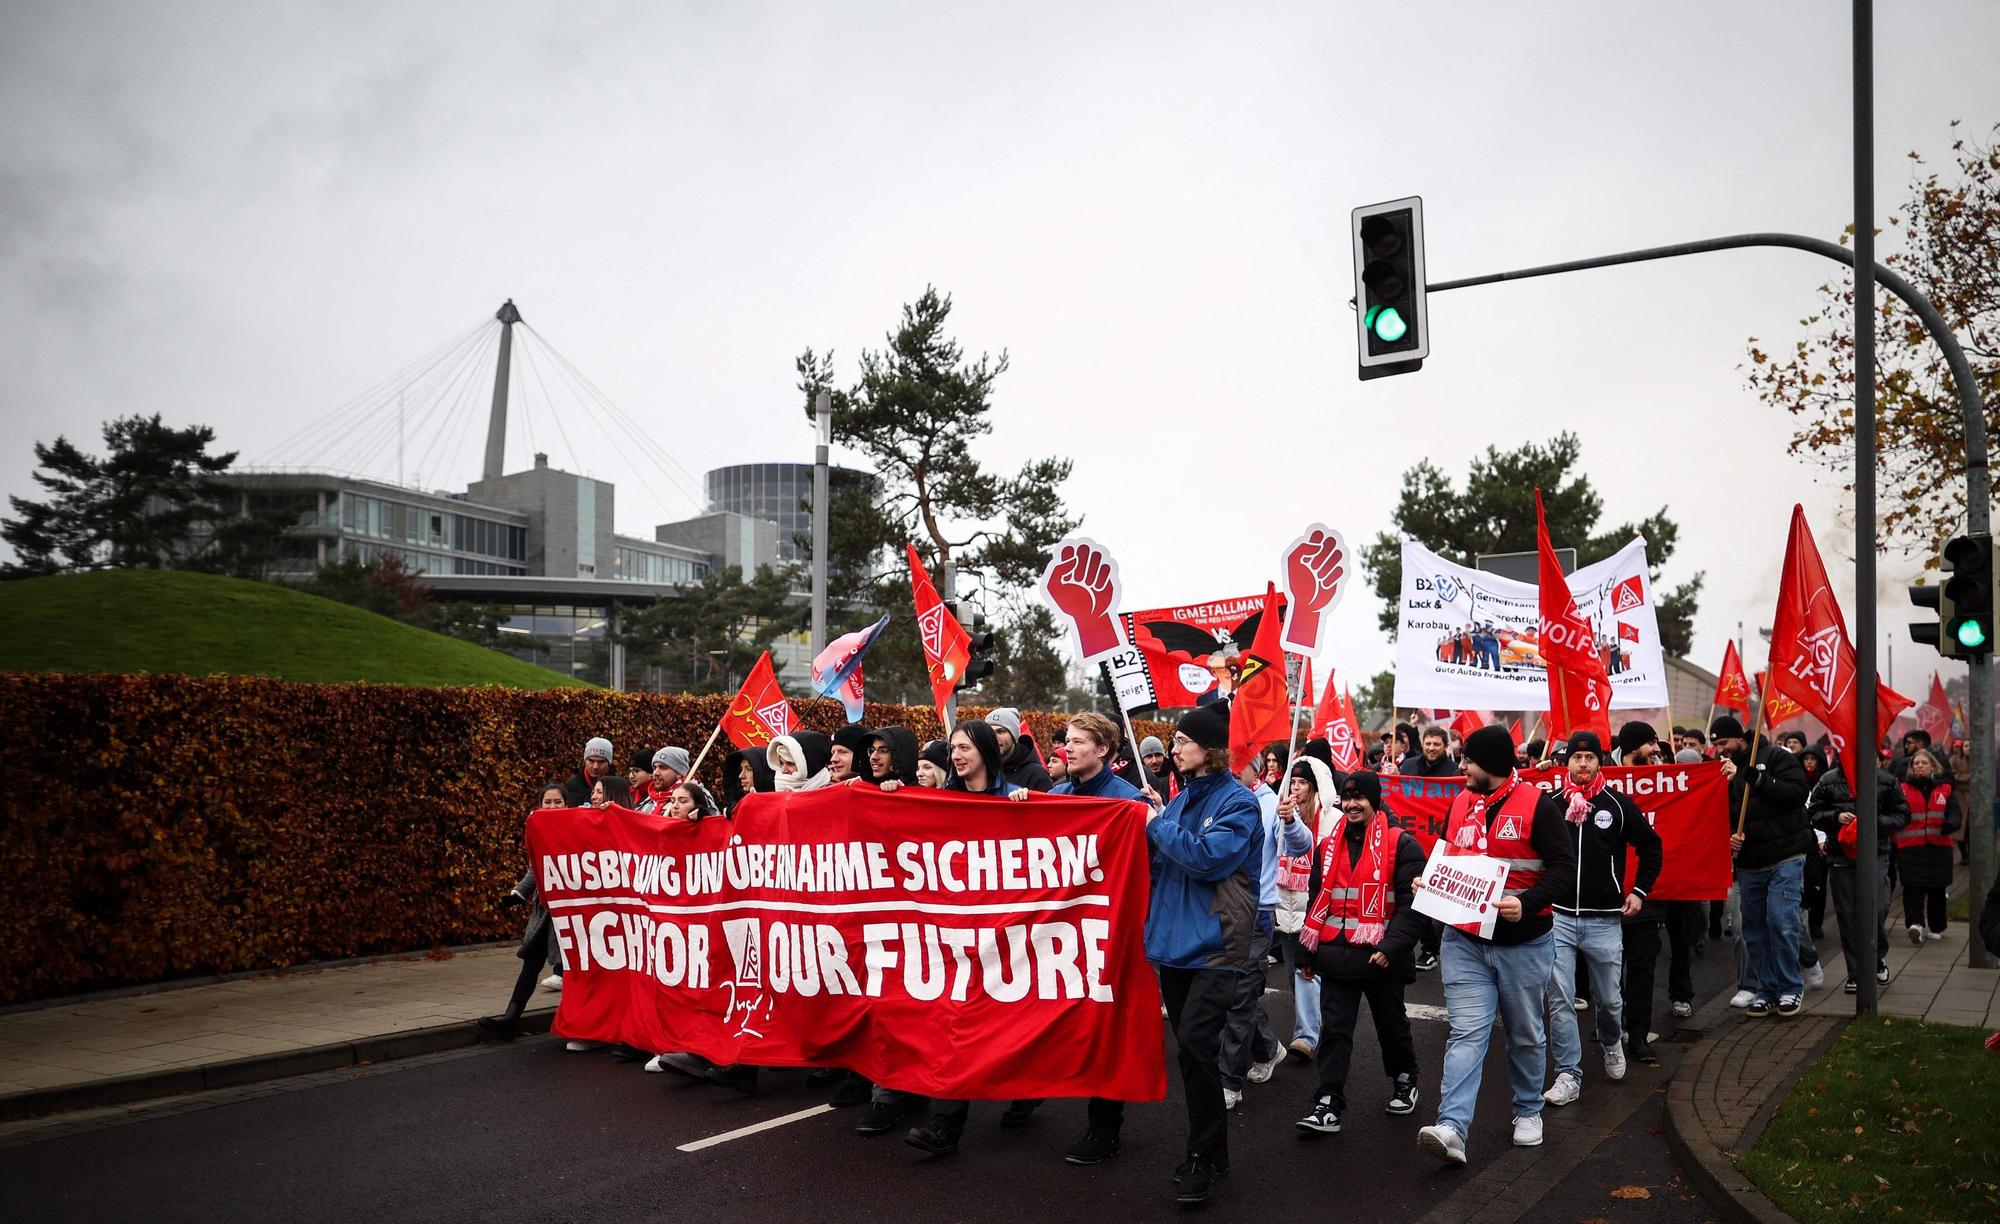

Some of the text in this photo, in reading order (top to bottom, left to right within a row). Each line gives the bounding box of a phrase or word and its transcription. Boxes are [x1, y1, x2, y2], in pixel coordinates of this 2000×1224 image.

[1416, 578, 1433, 590] B2
[1172, 598, 1265, 621] IGMETALLMAN
[1409, 599, 1442, 609] Lack &
[1407, 619, 1450, 630] Karobau
[1456, 668, 1482, 677] Autos
[1484, 671, 1526, 682] brauchen
[1120, 684, 1145, 698] zeigt
[1611, 771, 1689, 795] nicht
[726, 834, 895, 892] ÜBERNAHME
[896, 834, 1104, 893] SICHERN!
[1434, 863, 1488, 890] SOLIDARITÄT
[768, 921, 862, 998] OUR
[863, 918, 1114, 1003] FUTURE
